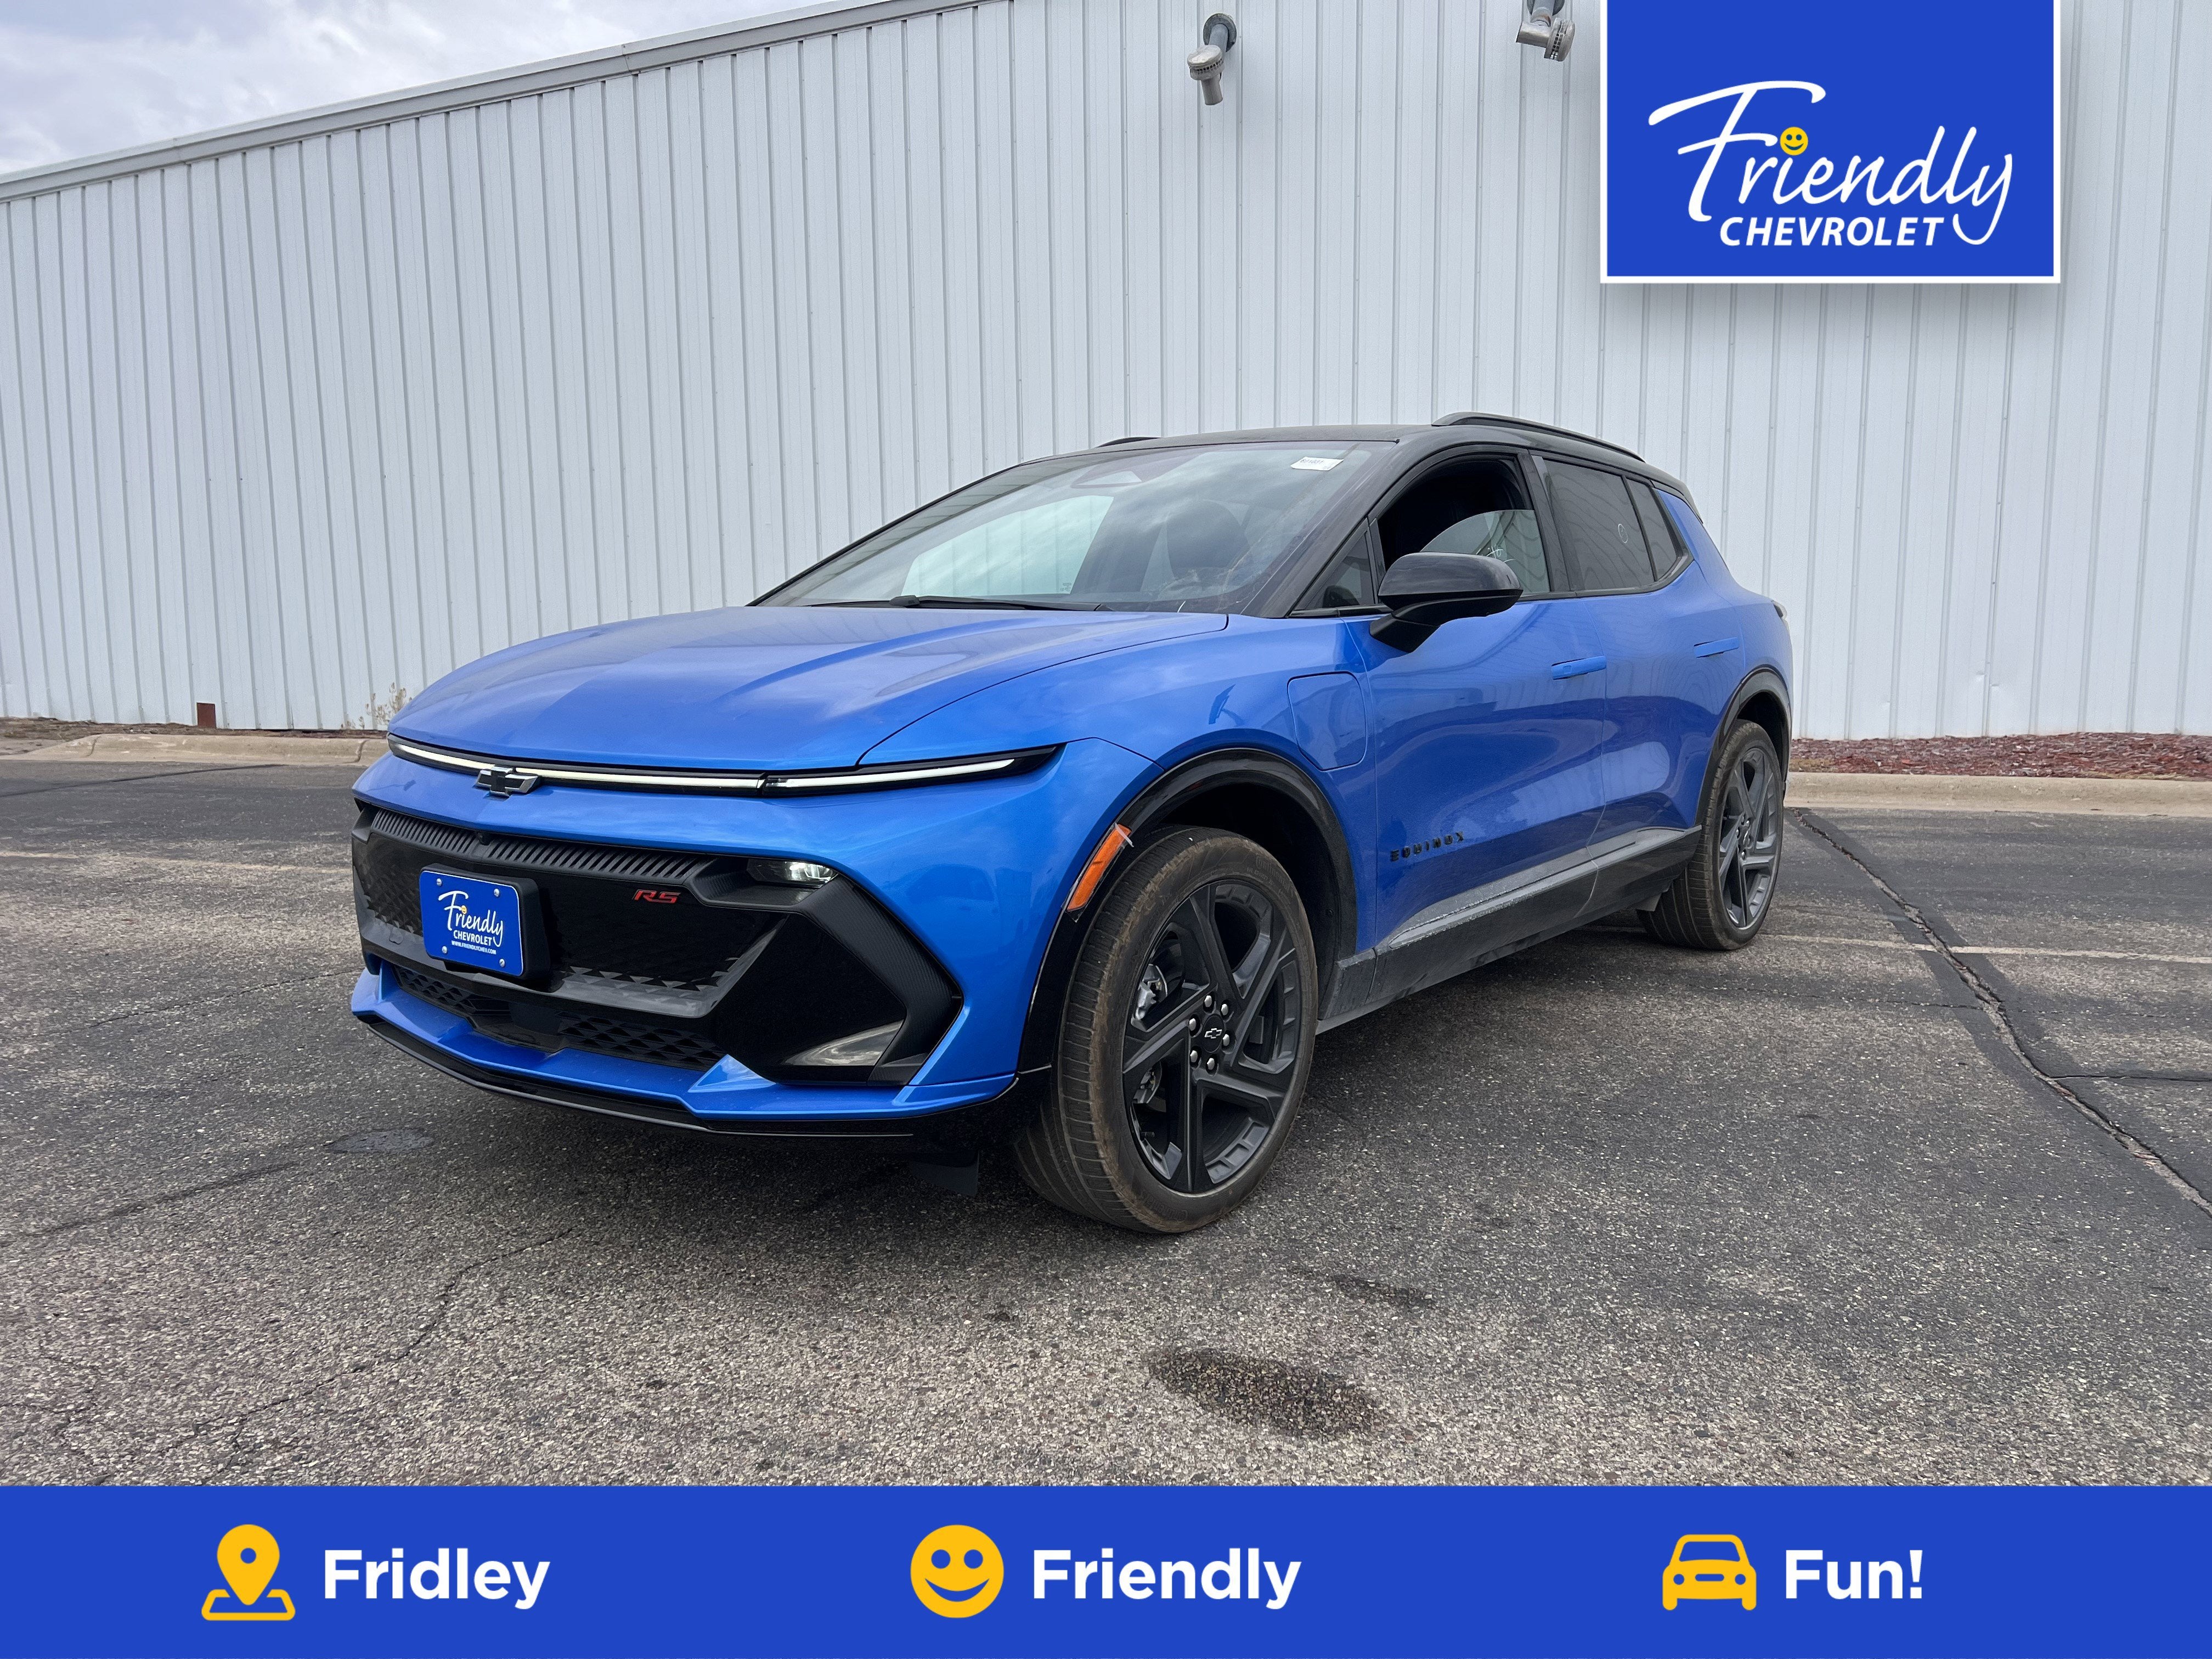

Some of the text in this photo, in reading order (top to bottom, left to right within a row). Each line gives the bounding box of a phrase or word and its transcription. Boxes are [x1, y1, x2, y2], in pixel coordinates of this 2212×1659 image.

[1390, 831, 1464, 862] EQUINOX
[631, 889, 681, 904] RS
[438, 890, 504, 947] Friendly
[453, 930, 493, 946] CHEVROLET
